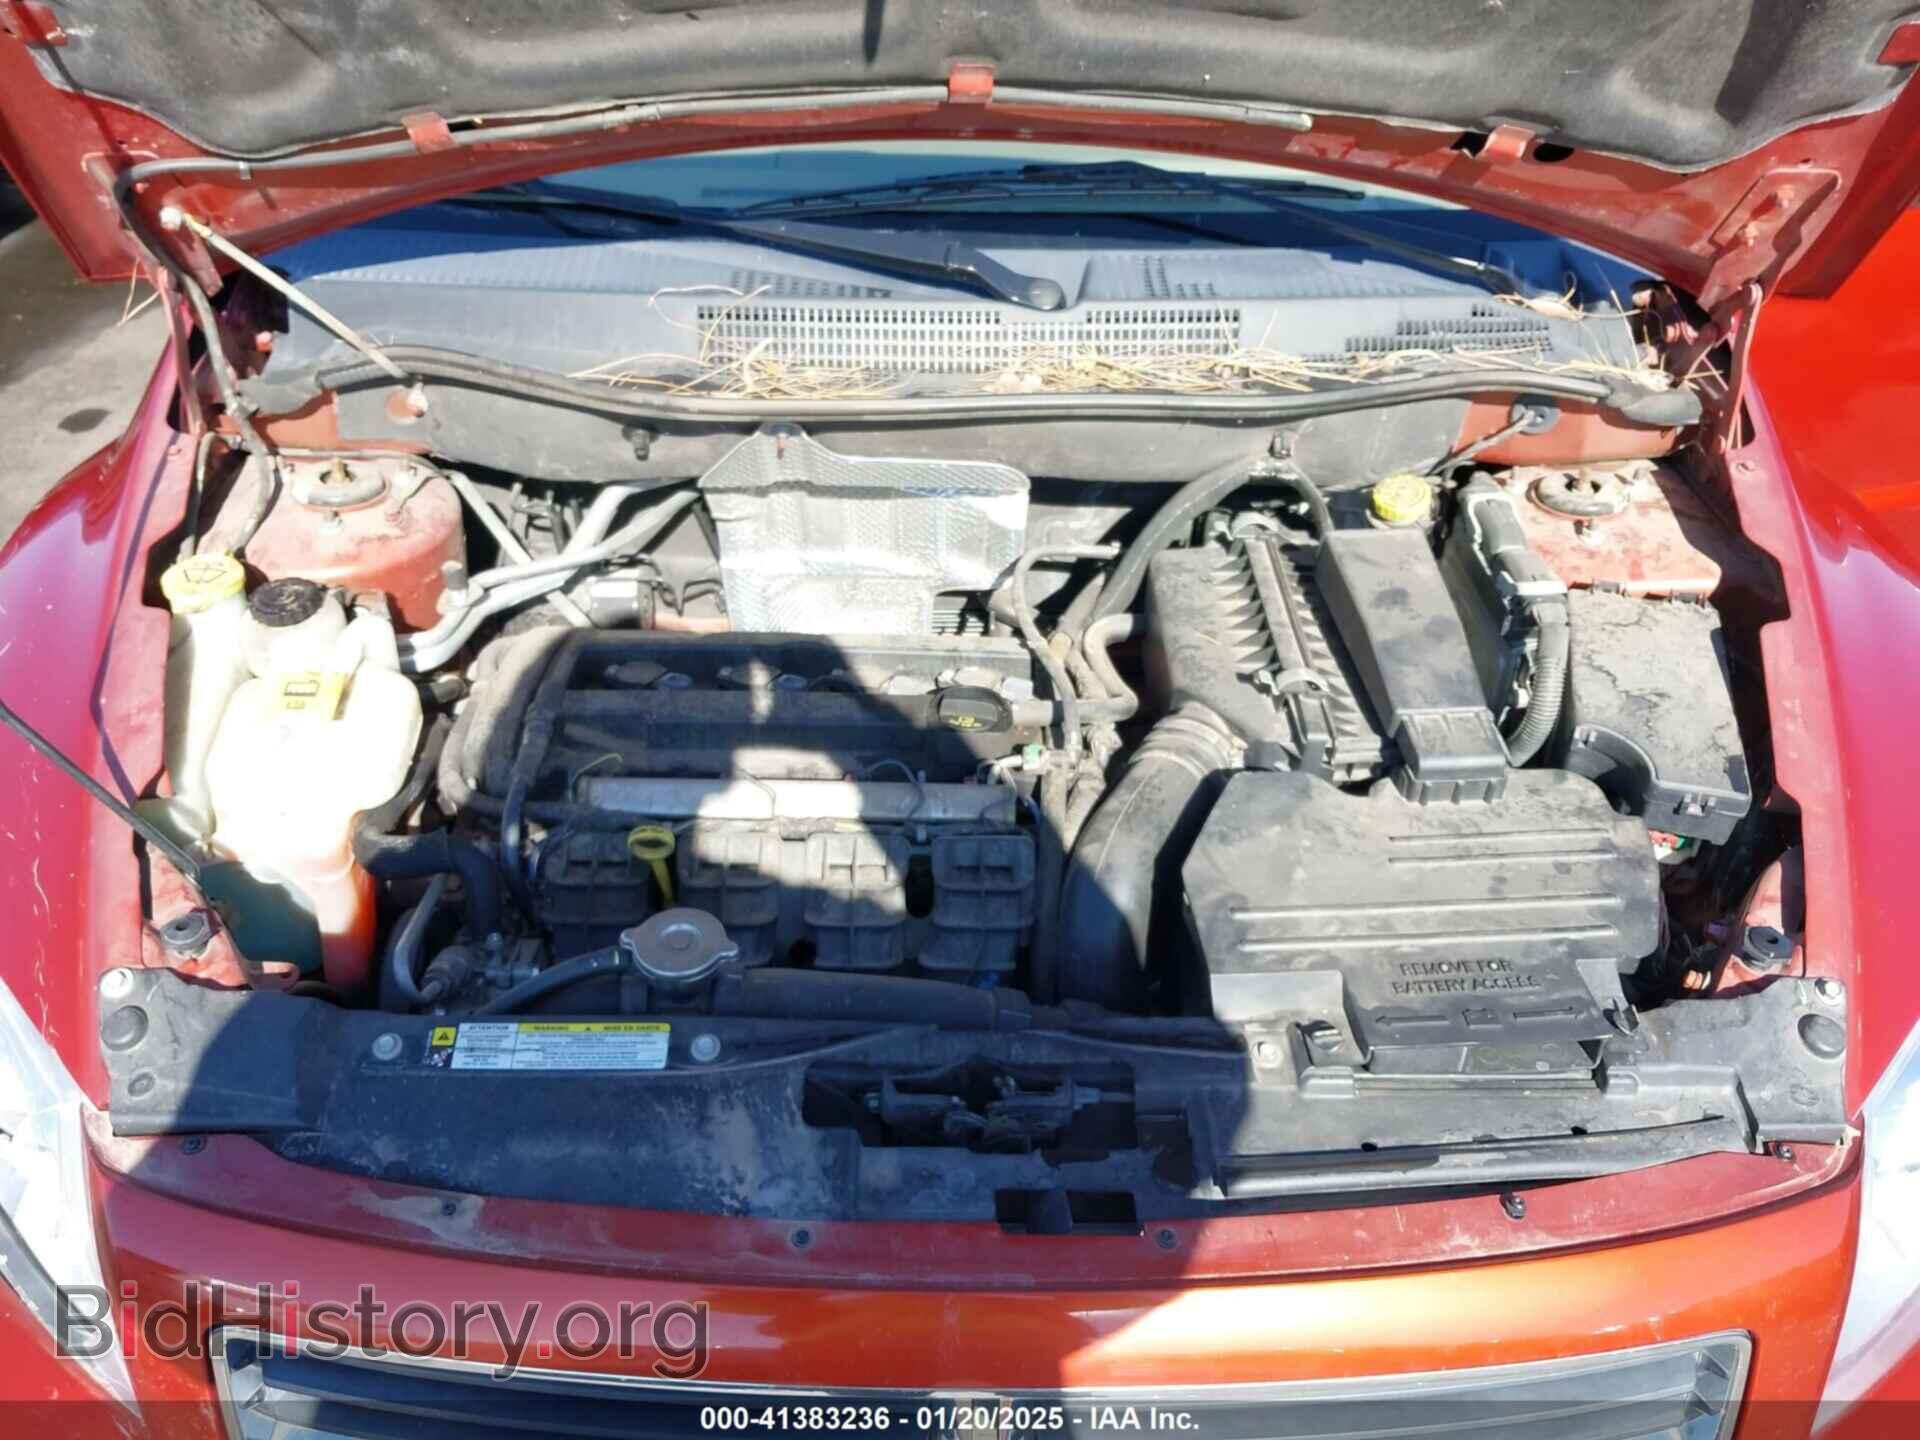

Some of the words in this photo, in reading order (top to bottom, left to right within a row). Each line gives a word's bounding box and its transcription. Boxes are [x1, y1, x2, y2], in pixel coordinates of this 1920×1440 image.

[1400, 959, 1475, 976] REMOVE
[1477, 959, 1514, 973] FOR
[1392, 978, 1468, 994] BATTERY
[1471, 976, 1541, 991] ACCESS
